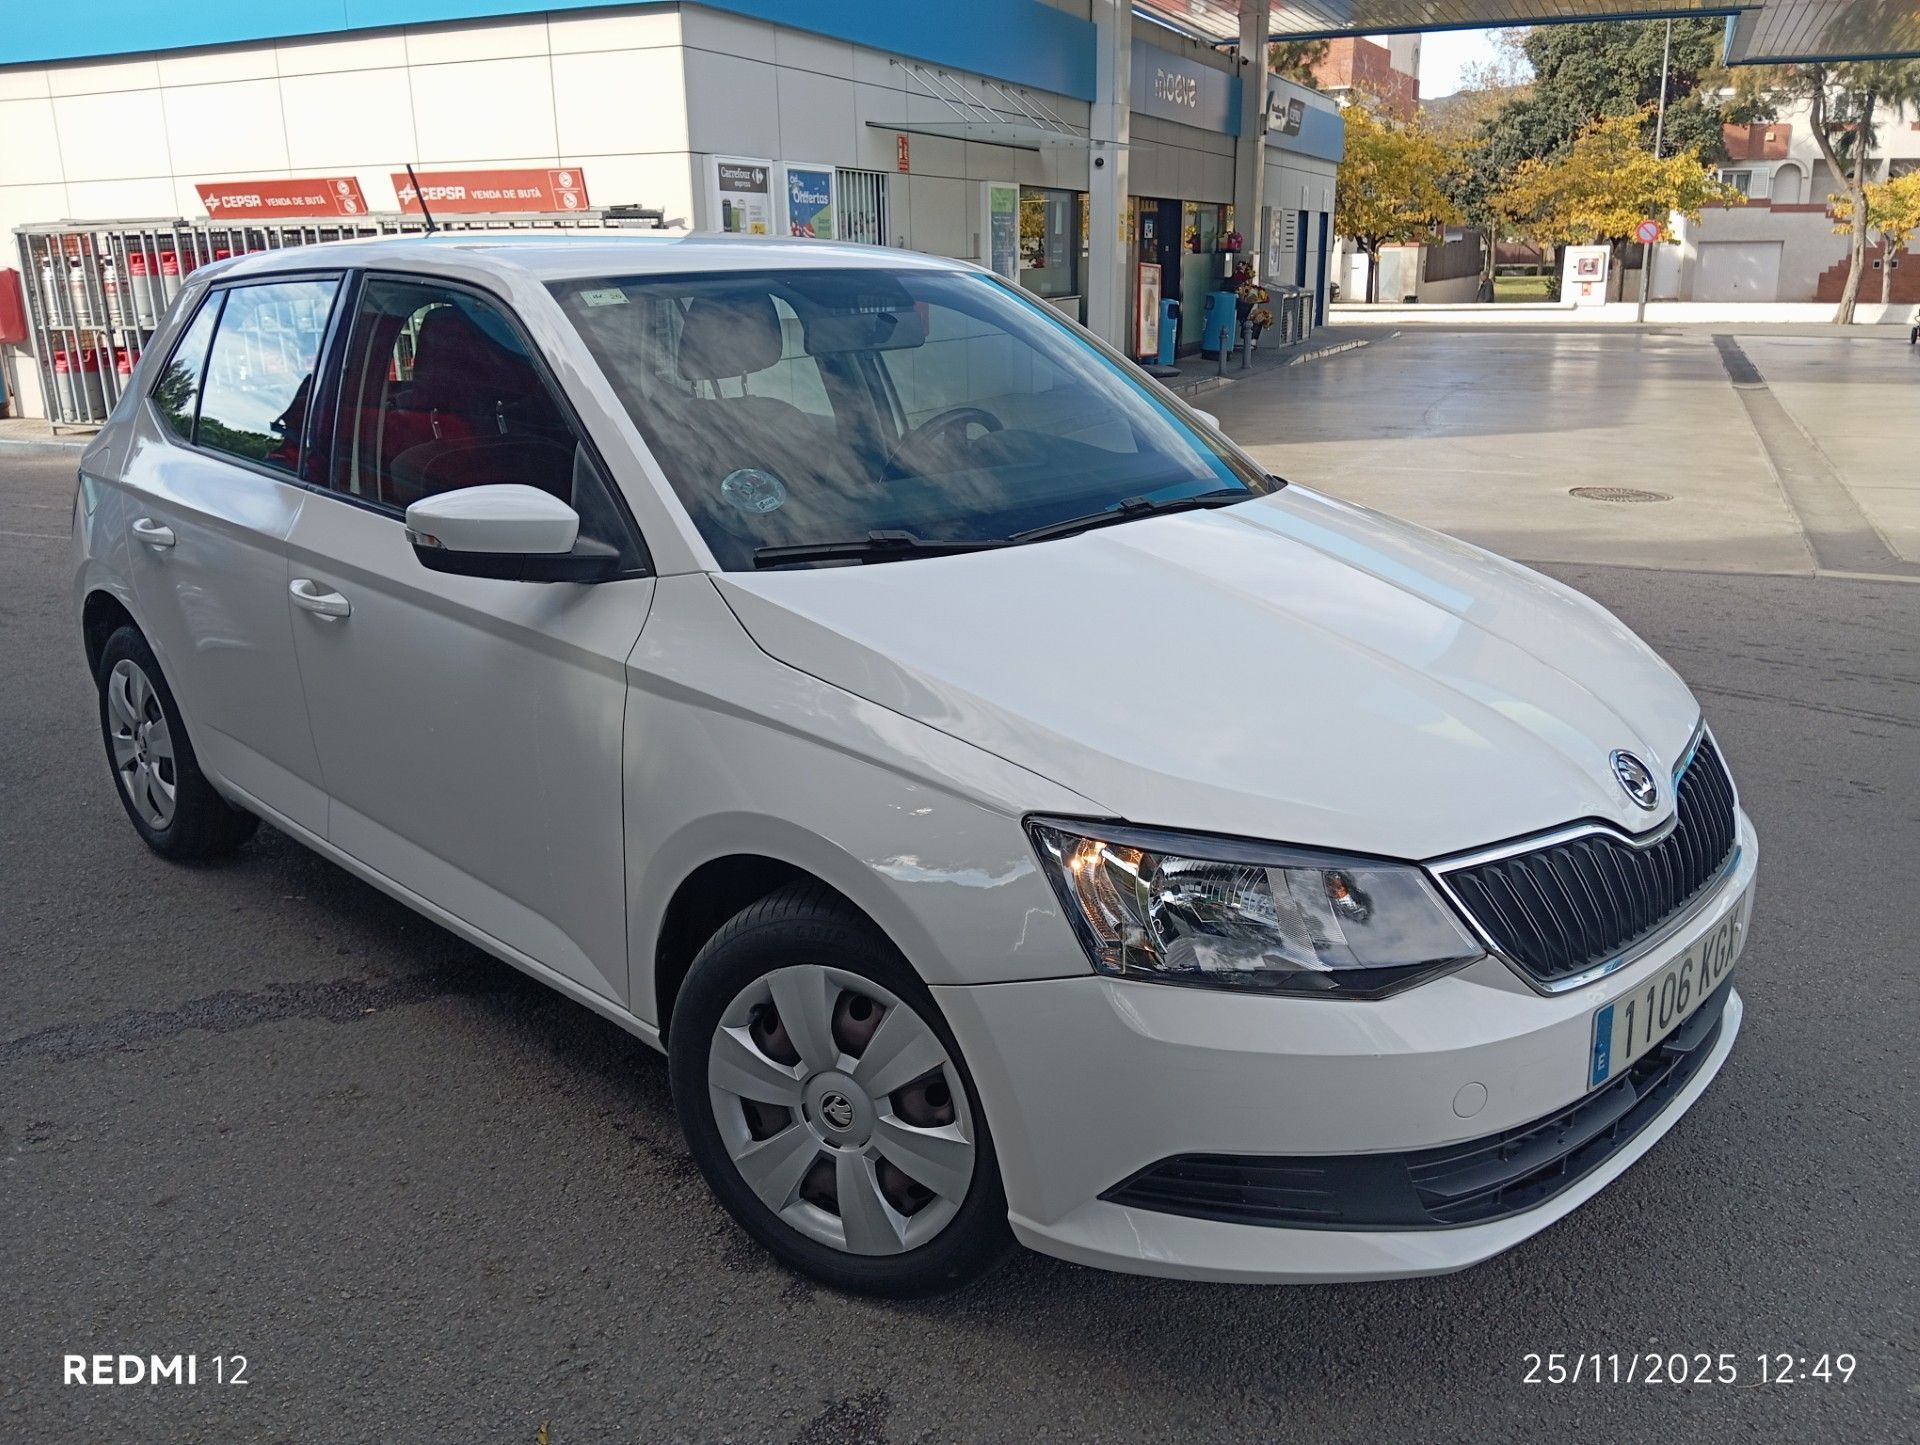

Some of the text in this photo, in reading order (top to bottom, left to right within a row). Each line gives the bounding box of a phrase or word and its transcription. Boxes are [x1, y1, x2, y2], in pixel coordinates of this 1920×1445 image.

[1155, 68, 1196, 108] moeve
[720, 166, 751, 179] Carrefour
[421, 186, 466, 200] CEPSA
[471, 190, 501, 200] VENDA
[503, 189, 517, 199] DE
[221, 195, 262, 208] CEPSA
[265, 197, 292, 207] VENDA
[293, 197, 305, 206] DE
[1625, 957, 1693, 1059] 1106
[1598, 1052, 1607, 1071] E
